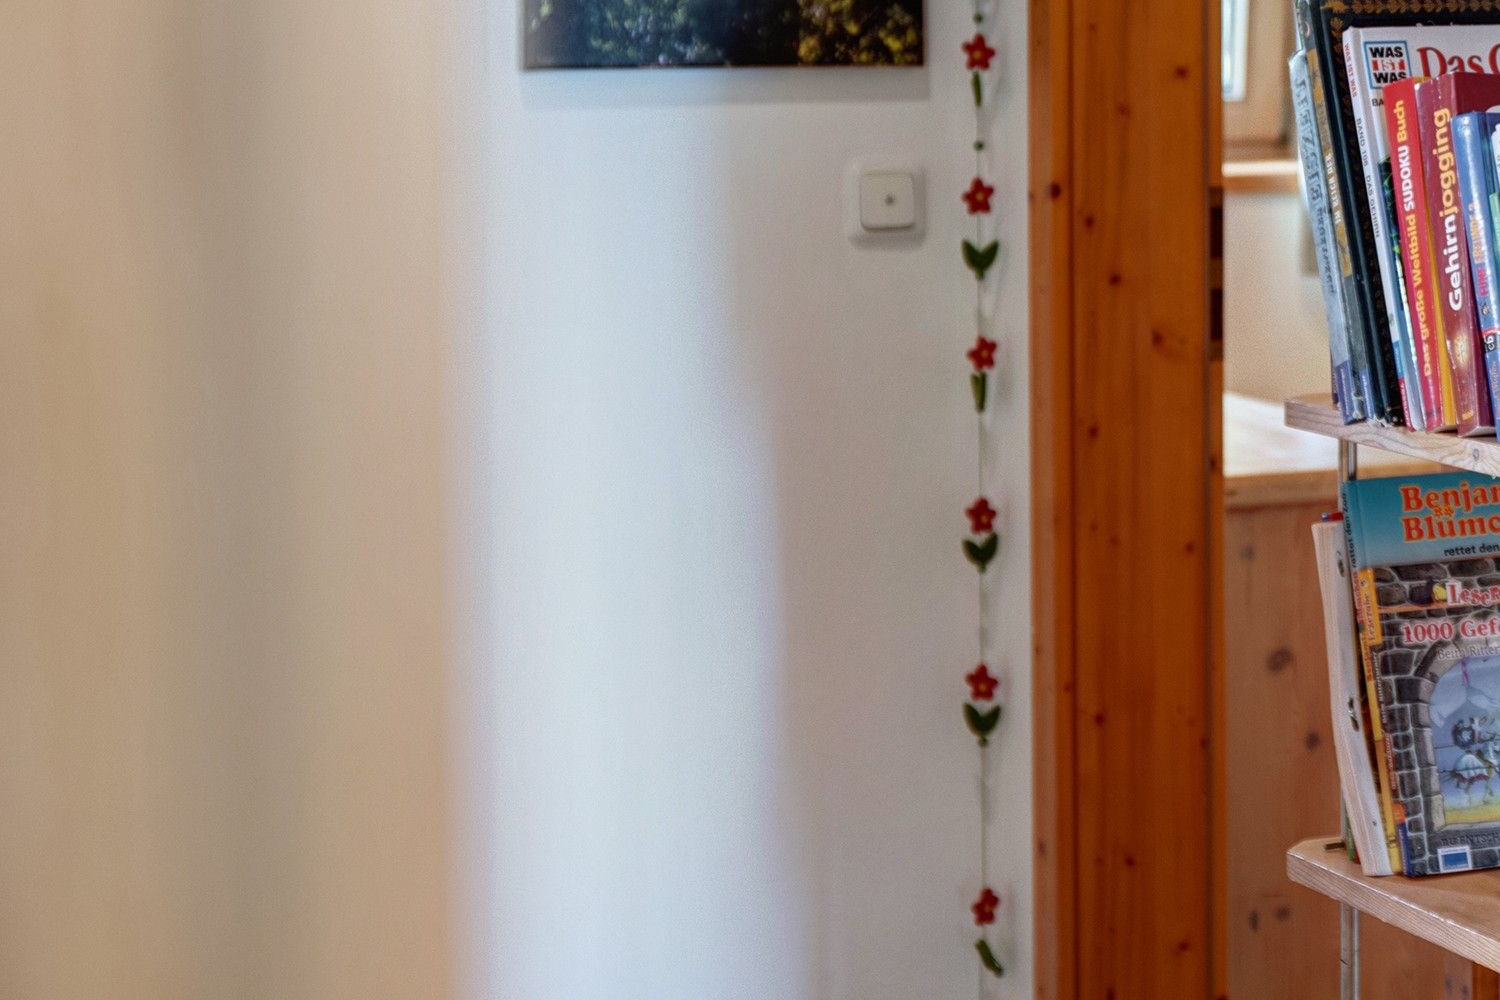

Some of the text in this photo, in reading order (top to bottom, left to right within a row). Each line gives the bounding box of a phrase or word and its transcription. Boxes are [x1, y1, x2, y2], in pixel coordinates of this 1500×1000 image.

[1368, 46, 1404, 58] WAS
[1415, 46, 1484, 75] Das
[1371, 59, 1405, 71] IST
[1373, 72, 1407, 84] WAS
[1356, 117, 1367, 148] BAND
[1365, 174, 1374, 196] DAS
[1368, 196, 1381, 238] GEHIRN
[1432, 107, 1464, 312] Gehirnjogging
[1392, 100, 1433, 377] Das große Weltbild SUDOKU Buch
[1443, 543, 1477, 557] rettet
[1478, 541, 1500, 555] den
[1402, 620, 1454, 644] 1000
